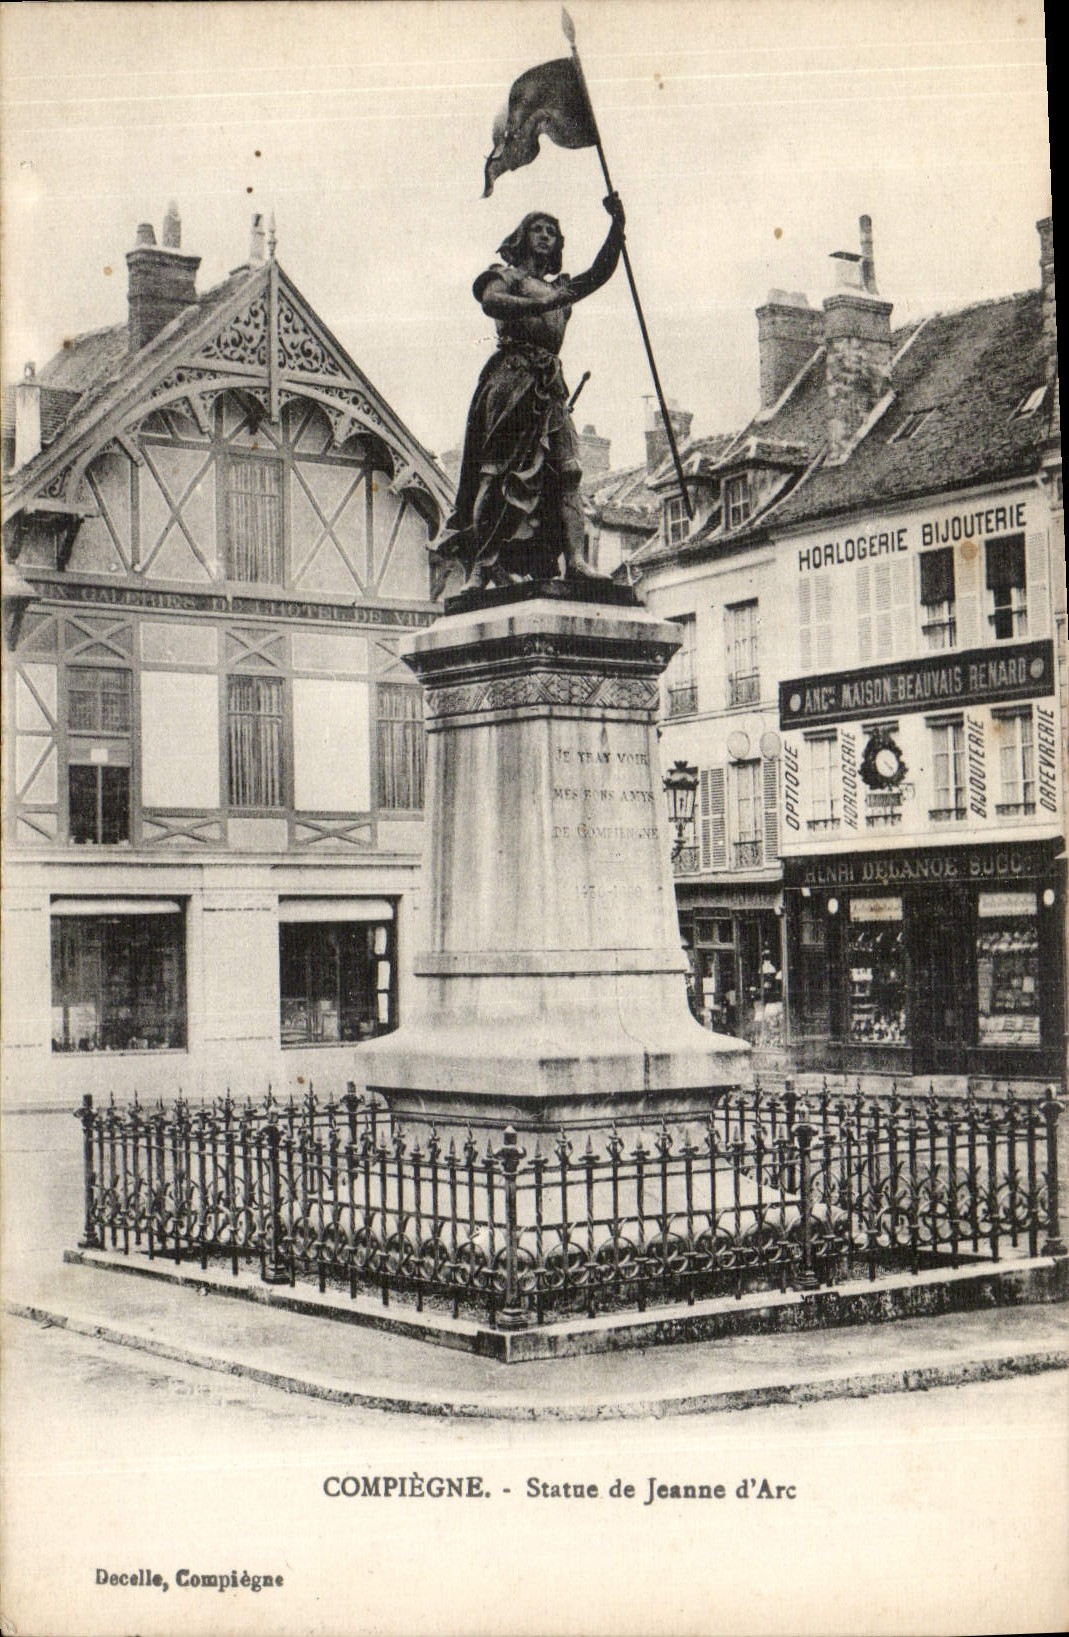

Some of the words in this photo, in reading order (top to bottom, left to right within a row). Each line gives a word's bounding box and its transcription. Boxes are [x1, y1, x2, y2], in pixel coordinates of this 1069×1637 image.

[798, 528, 908, 572] HORLOGERIE
[921, 502, 1028, 547] BIJOUTERIE
[841, 677, 892, 708] MAISON
[897, 666, 963, 701] BEAUVAIS
[784, 740, 801, 832] OPTIQUE
[841, 729, 859, 831] HORLOGERIE
[967, 714, 988, 819] BIJOUTERIE
[1036, 704, 1058, 813] ORFEVRERIE
[805, 863, 855, 883] HENRI
